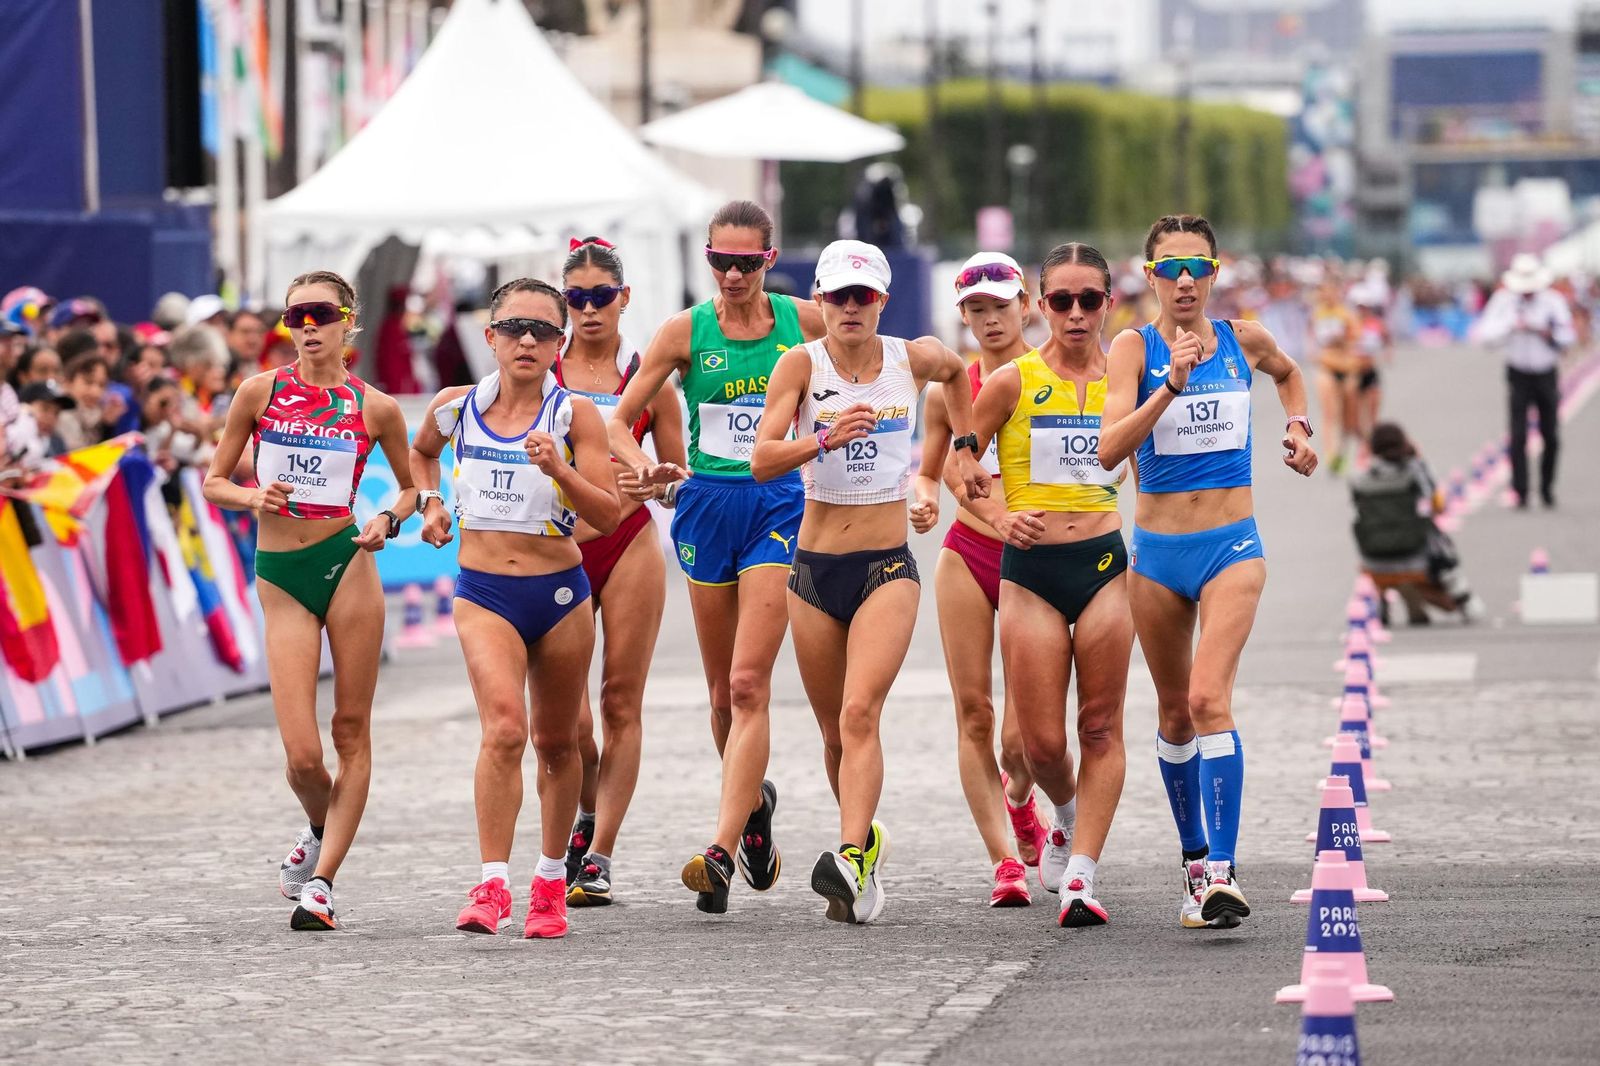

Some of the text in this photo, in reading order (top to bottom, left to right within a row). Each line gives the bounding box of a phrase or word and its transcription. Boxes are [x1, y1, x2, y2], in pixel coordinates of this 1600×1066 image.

[1202, 383, 1225, 391] 2024
[1186, 400, 1220, 422] 137
[273, 420, 355, 441] MÉXICO
[1177, 422, 1234, 436] PALMISANO
[282, 436, 332, 447] PARIS 2024
[1061, 435, 1099, 454] 102
[482, 450, 502, 459] PARIS
[503, 453, 526, 461] 2024
[842, 440, 879, 461] 123
[287, 454, 322, 475] 142
[846, 462, 876, 472] PEREZ
[277, 473, 327, 487] GONZALEZ
[490, 469, 515, 490] 117
[479, 490, 524, 502] MOREJON
